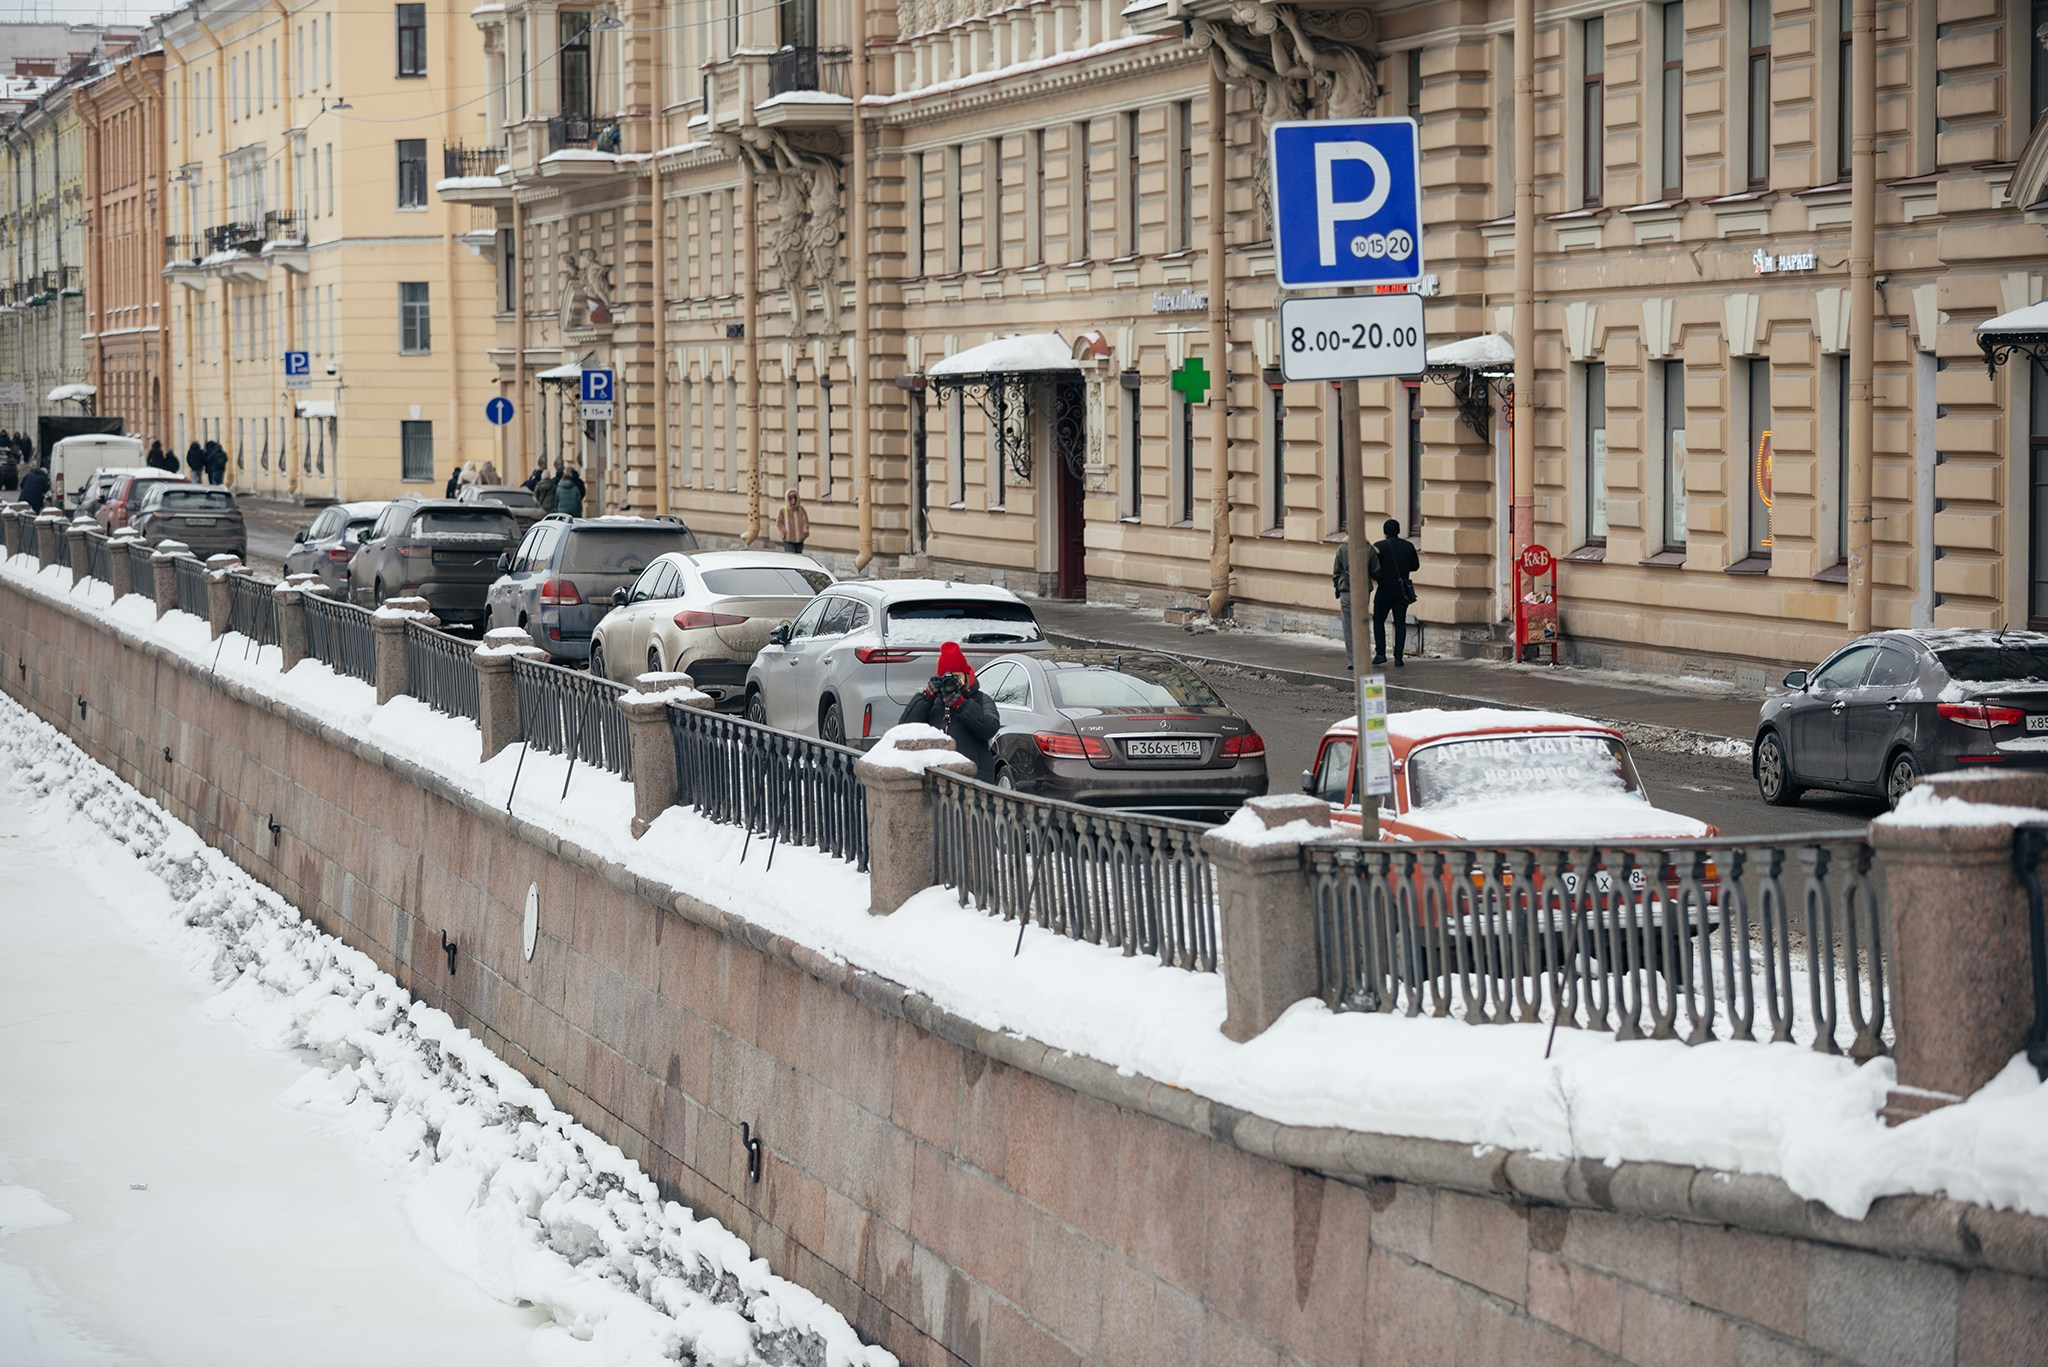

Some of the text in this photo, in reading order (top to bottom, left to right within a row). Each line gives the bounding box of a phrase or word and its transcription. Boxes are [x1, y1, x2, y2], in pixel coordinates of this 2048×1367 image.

[1314, 140, 1391, 267] P
[1355, 236, 1410, 254] 10 15 20
[1291, 323, 1417, 353] 8.00-20.00
[291, 353, 306, 374] P
[590, 372, 608, 399] P
[1523, 551, 1548, 567] К&Б
[1180, 741, 1198, 751] 178
[1437, 739, 1525, 763] АРЕНДА
